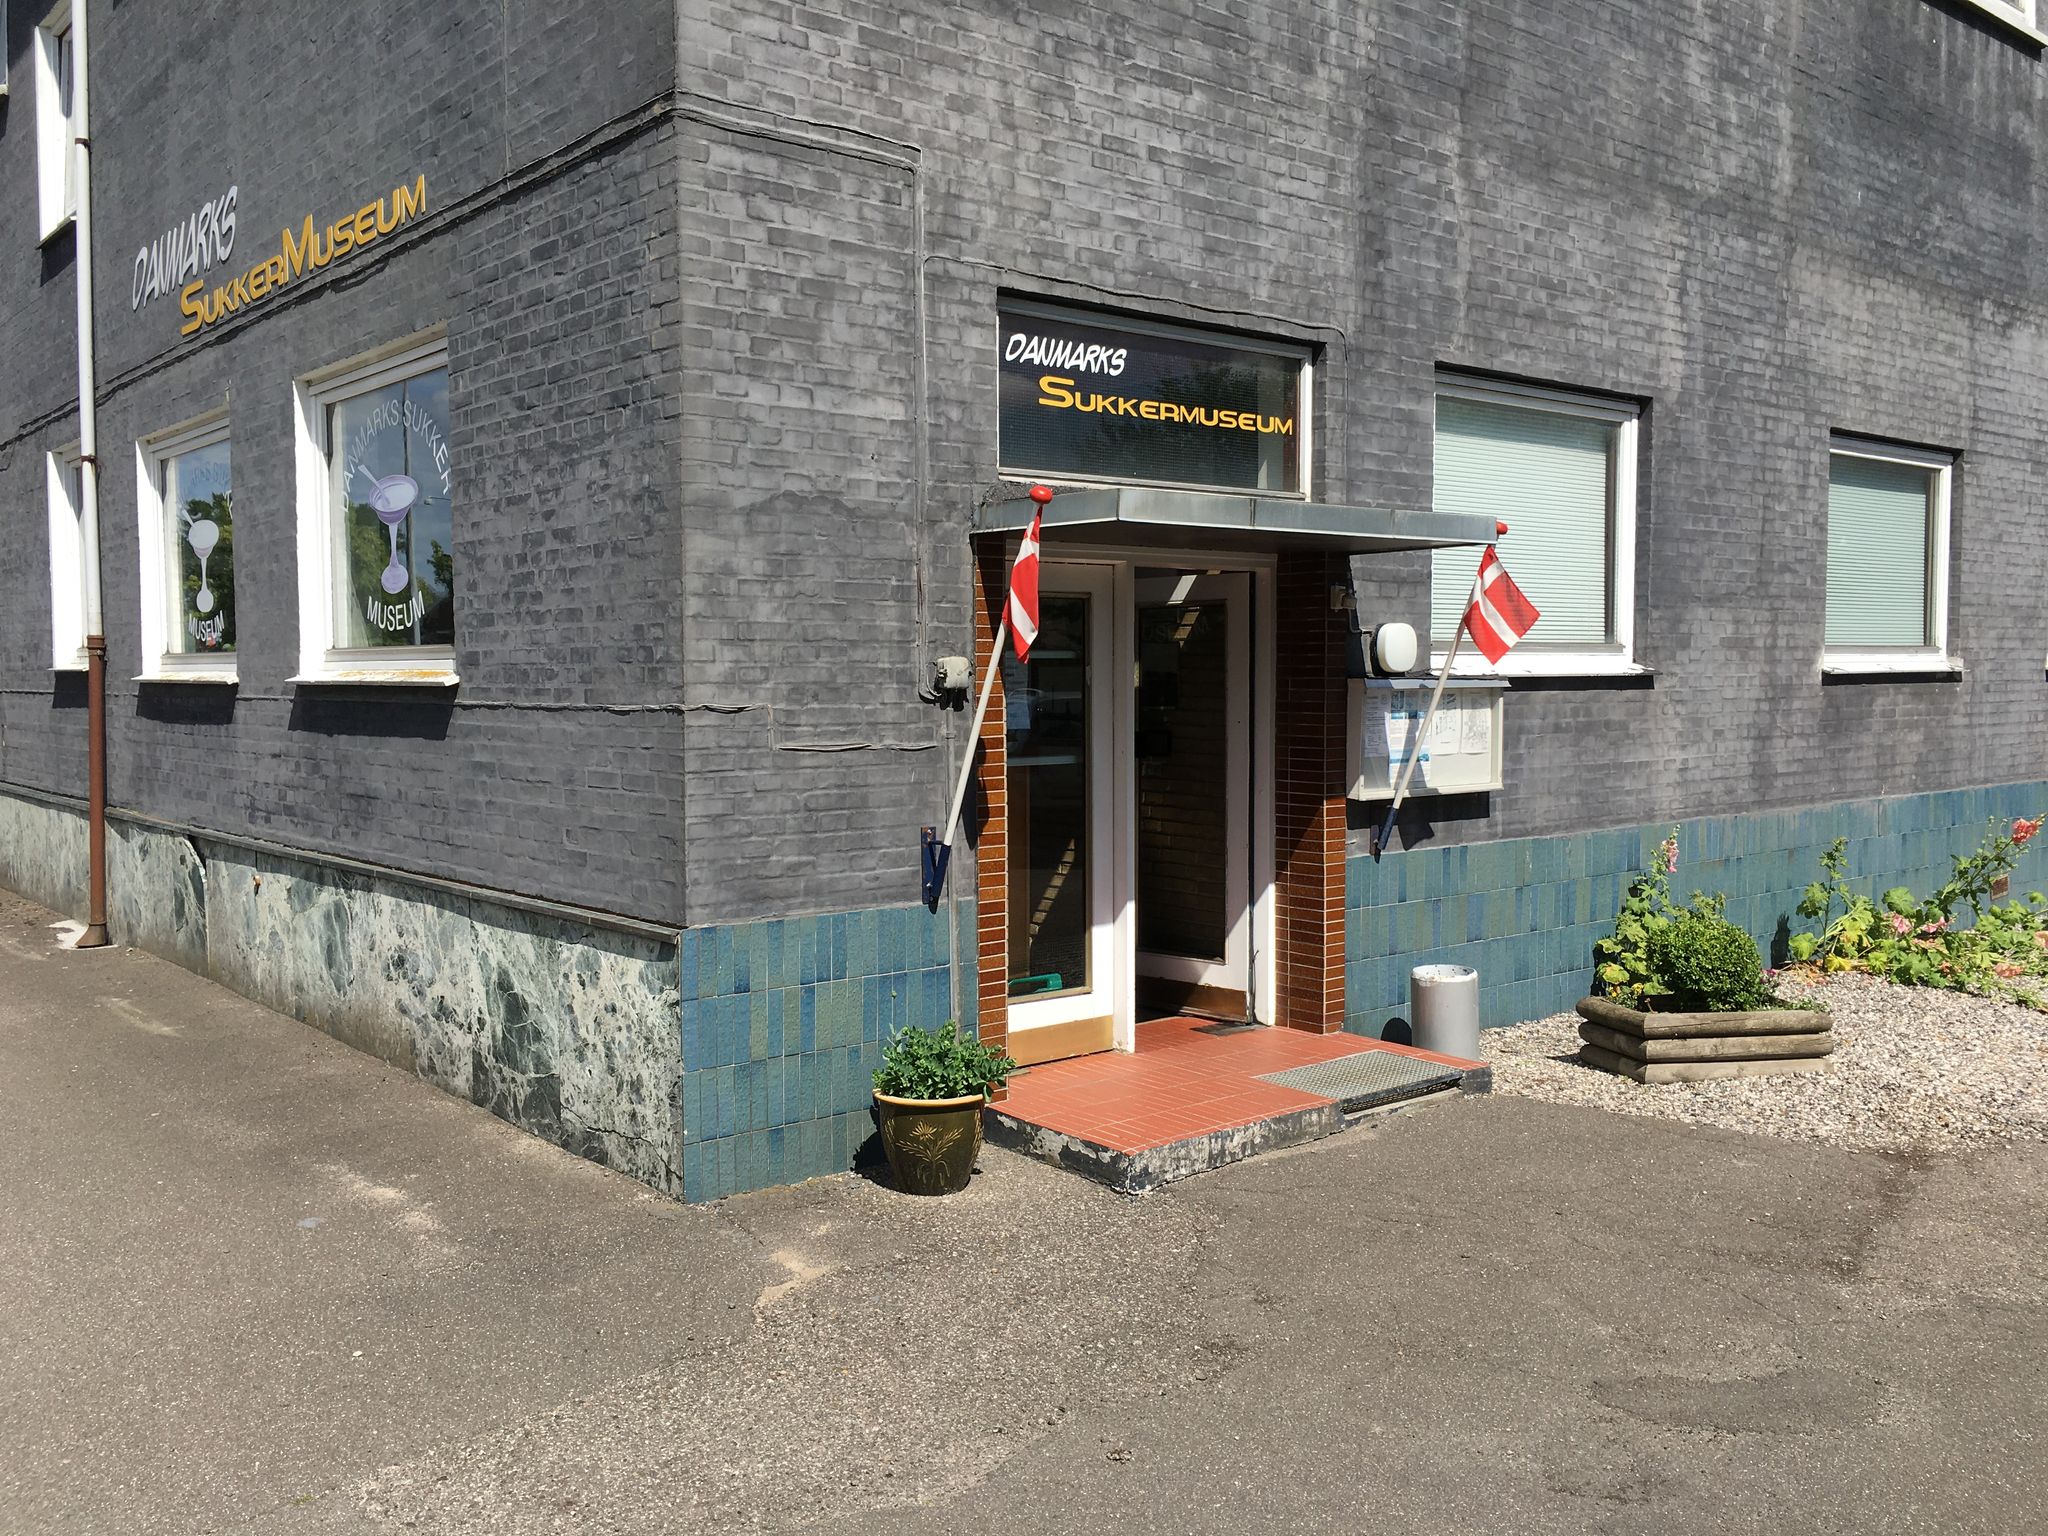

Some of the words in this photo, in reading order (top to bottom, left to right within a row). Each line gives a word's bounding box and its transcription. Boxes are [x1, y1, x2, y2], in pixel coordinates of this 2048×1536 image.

[133, 185, 238, 311] DANMARKS
[1004, 332, 1128, 377] DANMARKS
[1038, 375, 1293, 436] SUKKERMUSEUM
[339, 399, 399, 513] DANMARKS
[188, 609, 225, 643] MUSEUM
[366, 590, 426, 633] MUSEUM
